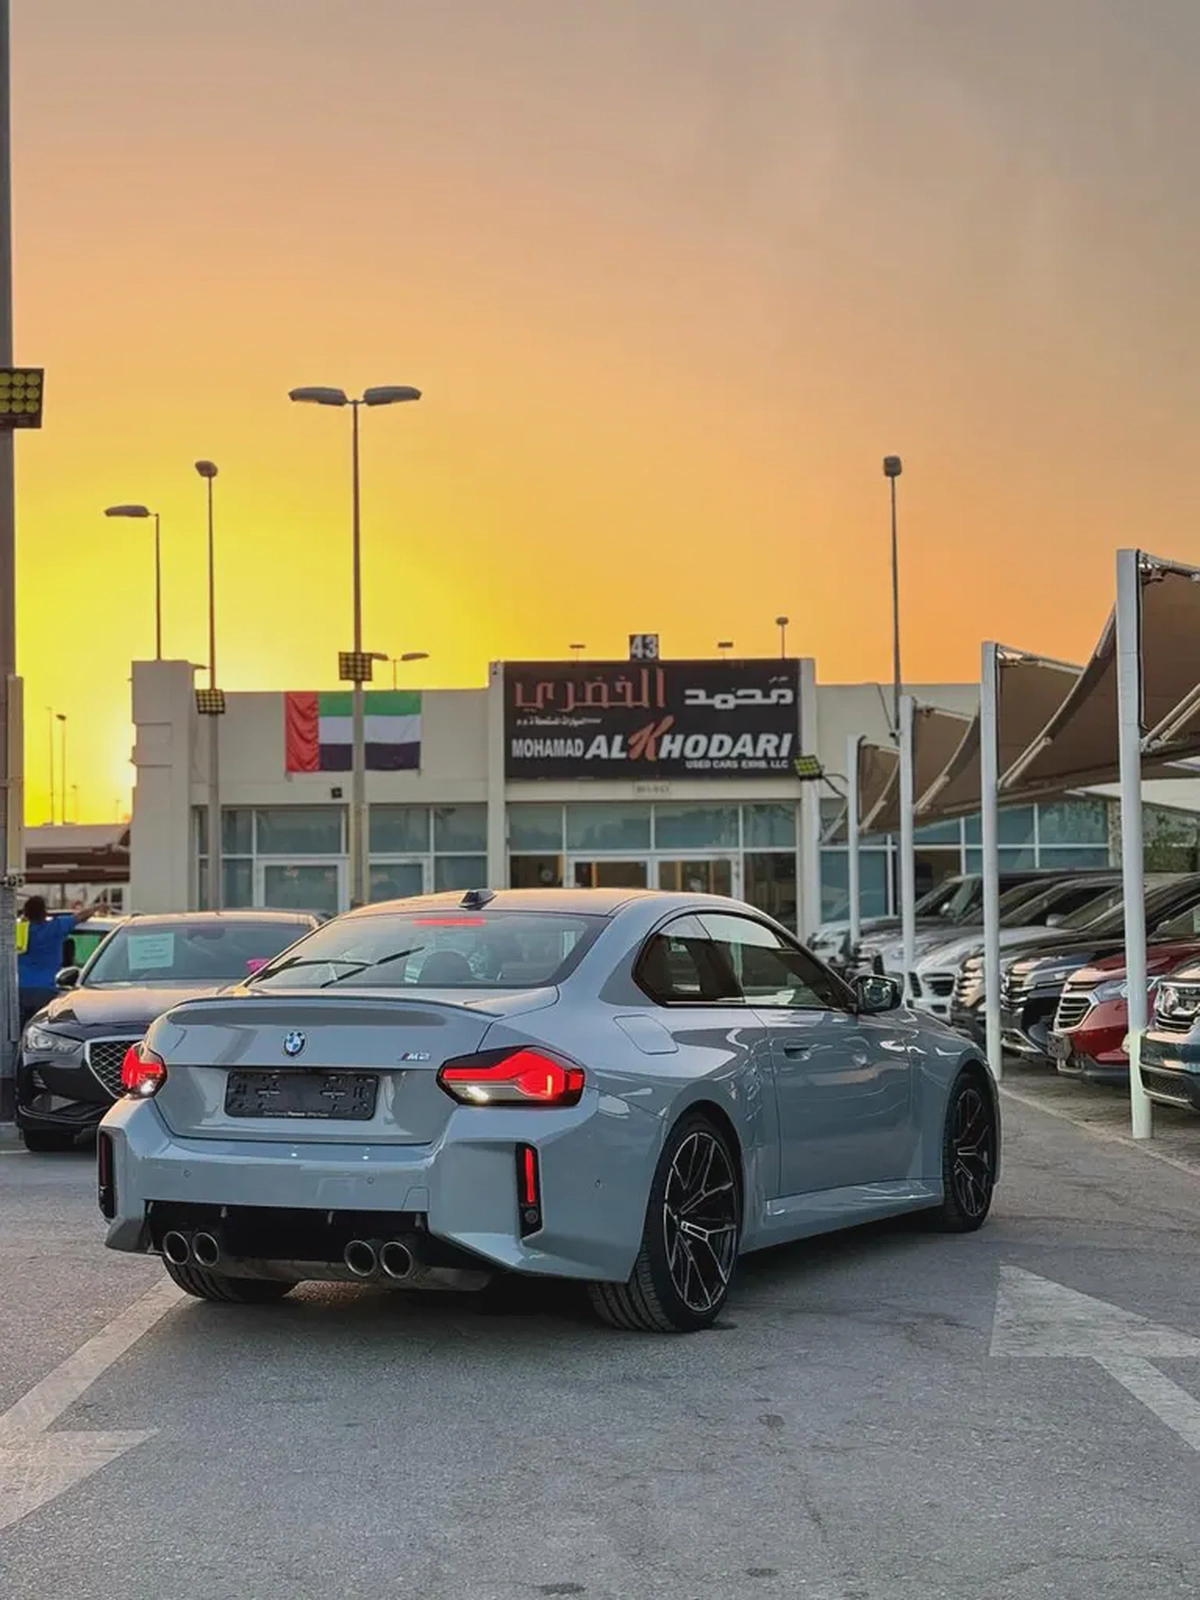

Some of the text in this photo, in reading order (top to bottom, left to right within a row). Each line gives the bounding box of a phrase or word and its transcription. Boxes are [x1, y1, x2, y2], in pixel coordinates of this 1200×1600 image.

[632, 635, 657, 659] 43
[514, 667, 794, 713] محمد الخضري
[512, 738, 584, 758] MOHAMAD
[584, 734, 627, 760] AL
[685, 760, 711, 769] USED
[712, 760, 738, 769] CARS
[770, 760, 789, 768] LLC
